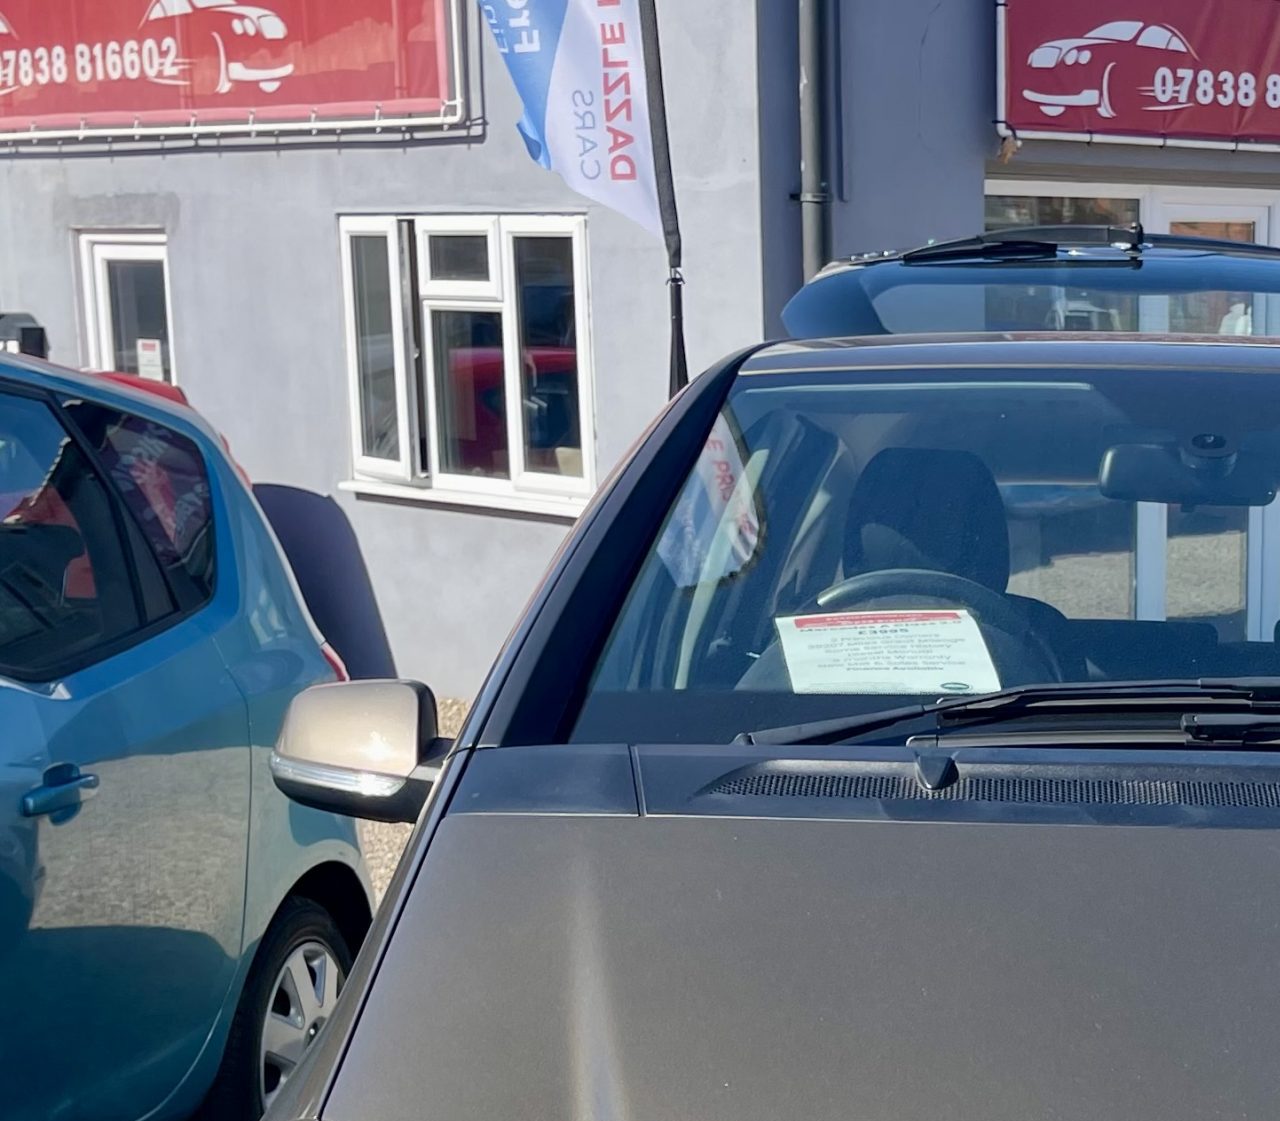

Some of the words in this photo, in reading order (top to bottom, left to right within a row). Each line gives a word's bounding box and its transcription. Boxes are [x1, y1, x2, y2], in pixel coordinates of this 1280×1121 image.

[0, 45, 68, 86] 7838
[75, 36, 179, 82] 816602
[1153, 66, 1257, 107] 07838
